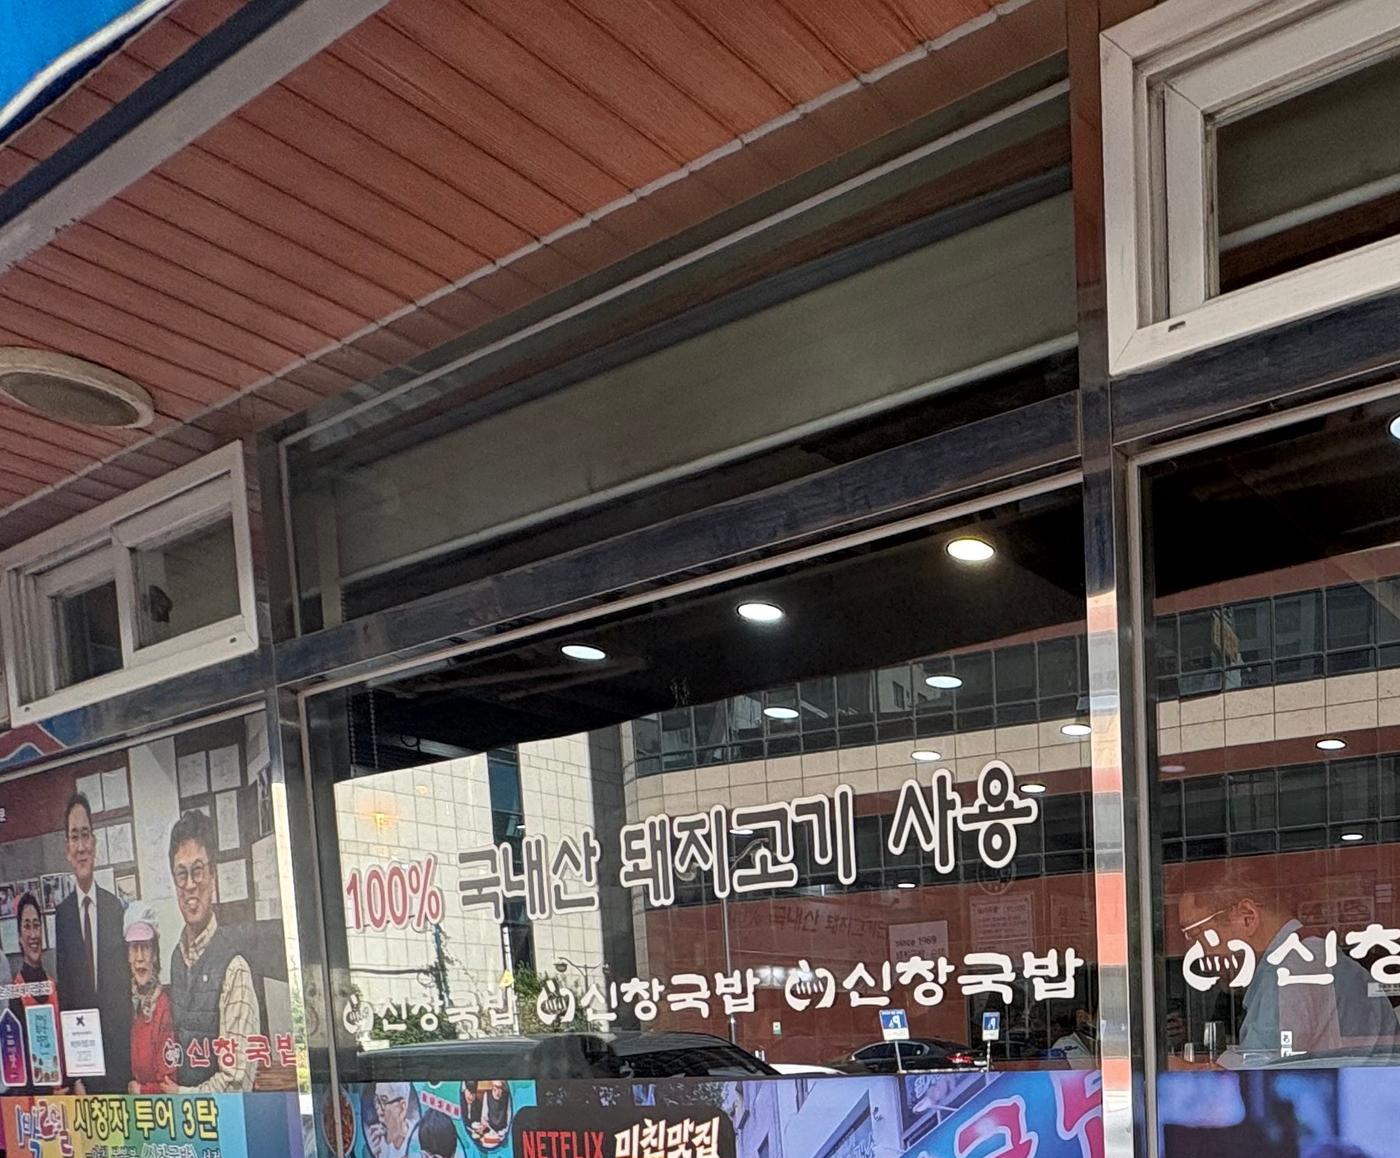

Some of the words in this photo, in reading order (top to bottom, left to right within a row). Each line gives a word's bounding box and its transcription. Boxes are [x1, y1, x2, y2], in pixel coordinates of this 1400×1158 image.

[345, 854, 442, 933] 100%
[457, 825, 600, 922] 국내산
[620, 784, 857, 907] 돼지고기
[888, 760, 1038, 875] 사용
[580, 967, 759, 1024] 신창국밥
[841, 948, 1085, 1008] 신창국밥
[374, 983, 518, 1036] 신창국밥
[74, 1097, 130, 1139] 시청자
[134, 1098, 177, 1140] 투어
[183, 1097, 219, 1141] 3탄
